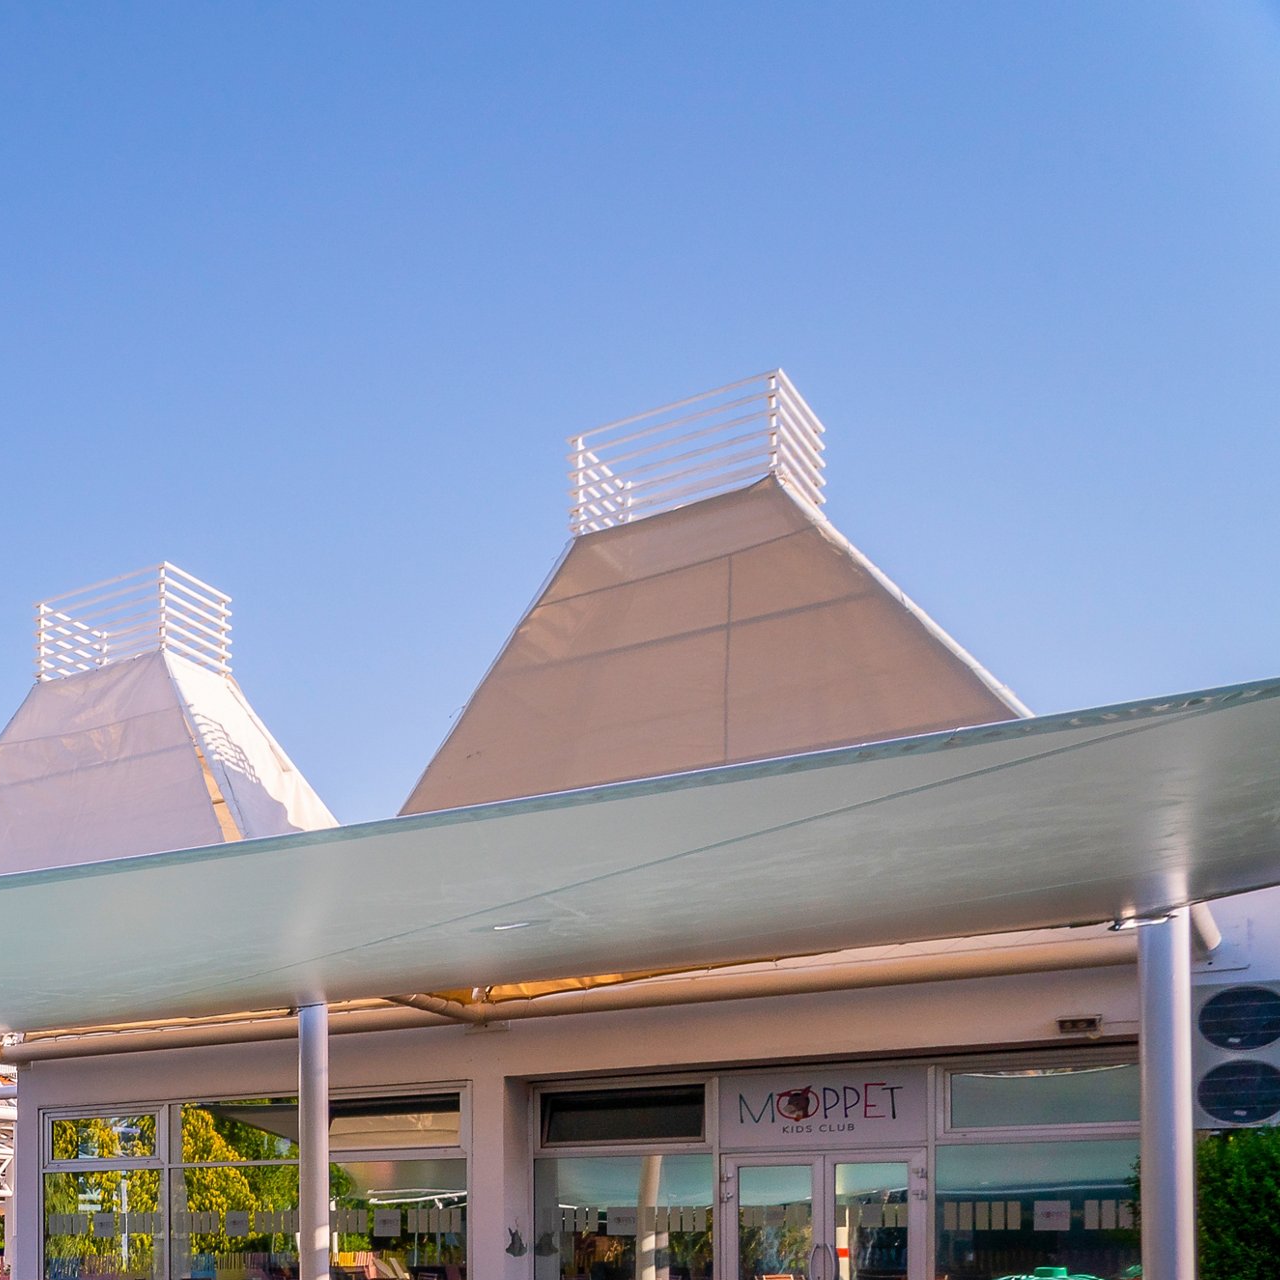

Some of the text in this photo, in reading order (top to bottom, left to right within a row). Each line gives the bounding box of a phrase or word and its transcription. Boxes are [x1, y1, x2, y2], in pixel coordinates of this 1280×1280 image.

[738, 1082, 903, 1124] MOPPET
[781, 1123, 856, 1135] KIDS CLUB
